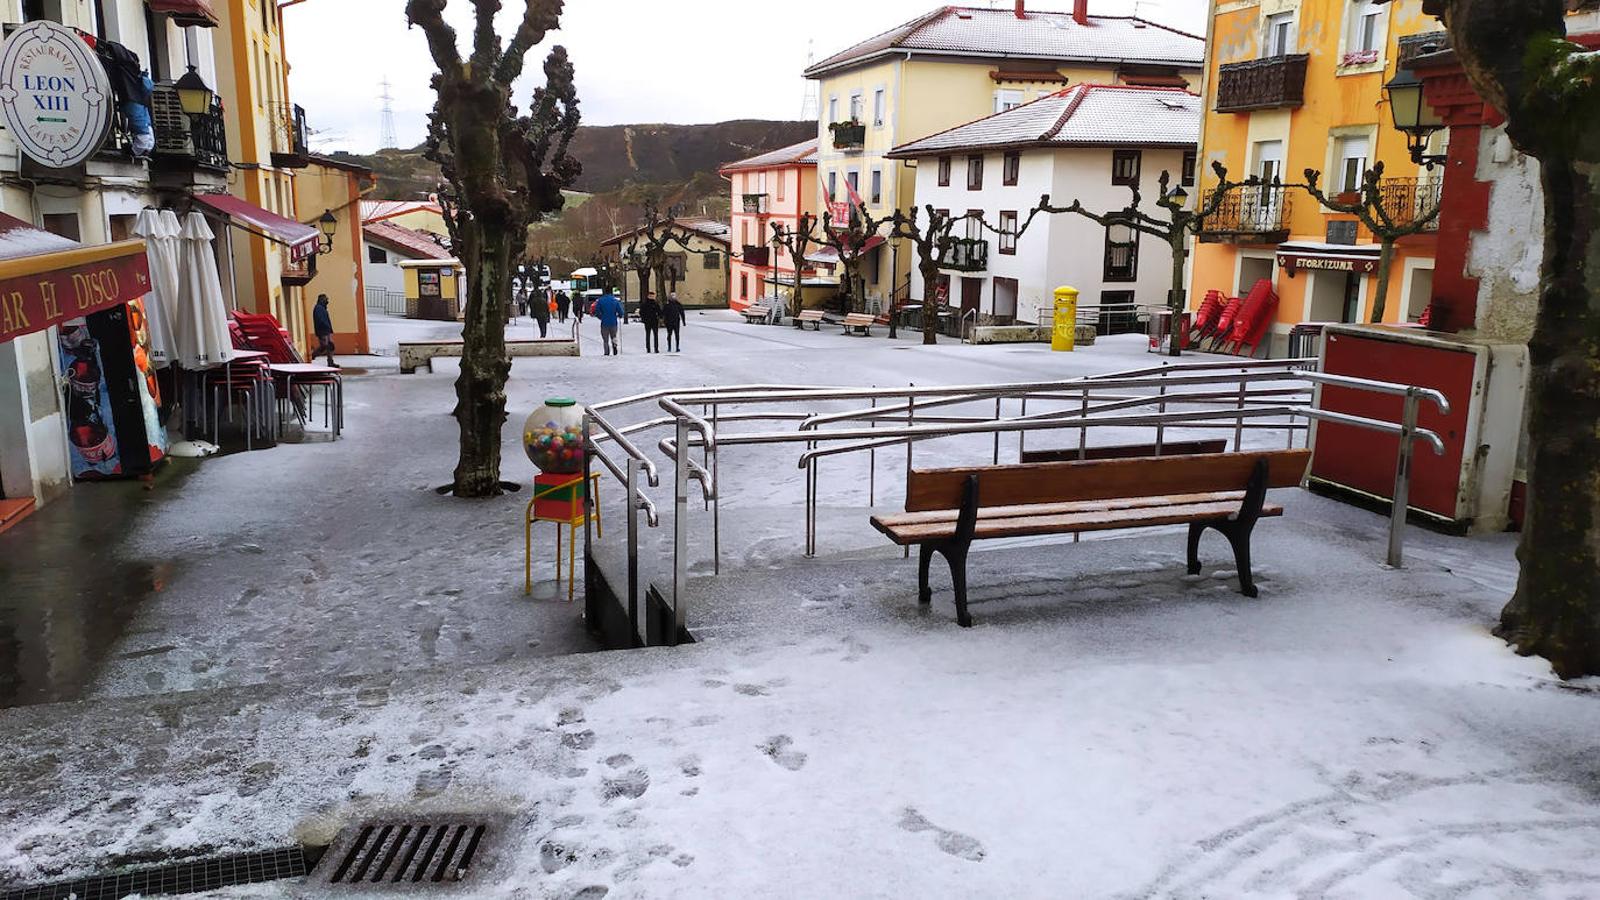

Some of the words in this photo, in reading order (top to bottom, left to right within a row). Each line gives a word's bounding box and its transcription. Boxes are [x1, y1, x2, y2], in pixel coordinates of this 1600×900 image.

[24, 75, 75, 92] LEON
[33, 95, 69, 111] XIII
[1296, 258, 1354, 271] ETORKIZUNA
[39, 281, 63, 320] EL
[72, 268, 119, 309] DISCO
